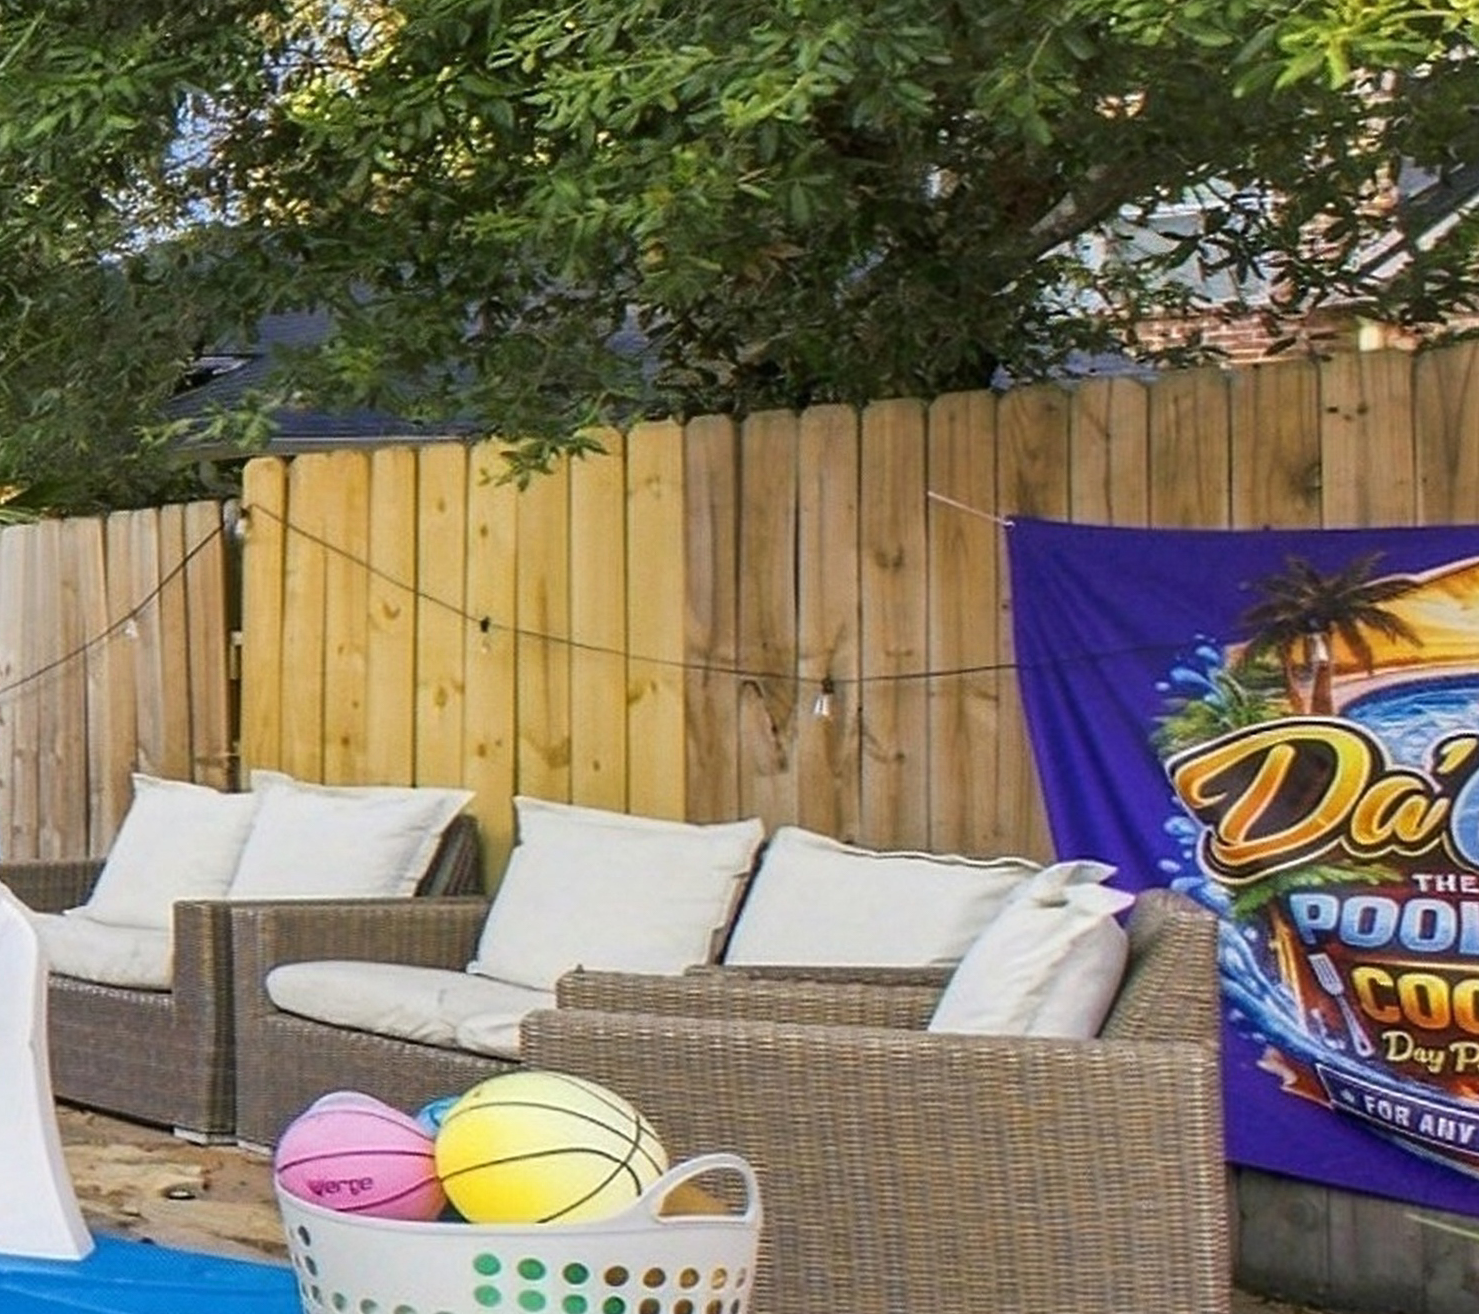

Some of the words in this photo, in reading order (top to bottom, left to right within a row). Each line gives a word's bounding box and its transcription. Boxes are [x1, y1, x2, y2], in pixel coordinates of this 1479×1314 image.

[1382, 1031, 1446, 1074] Day
[1449, 1040, 1479, 1073] P
[1364, 1095, 1411, 1127] FOR
[1419, 1113, 1475, 1145] ANY
